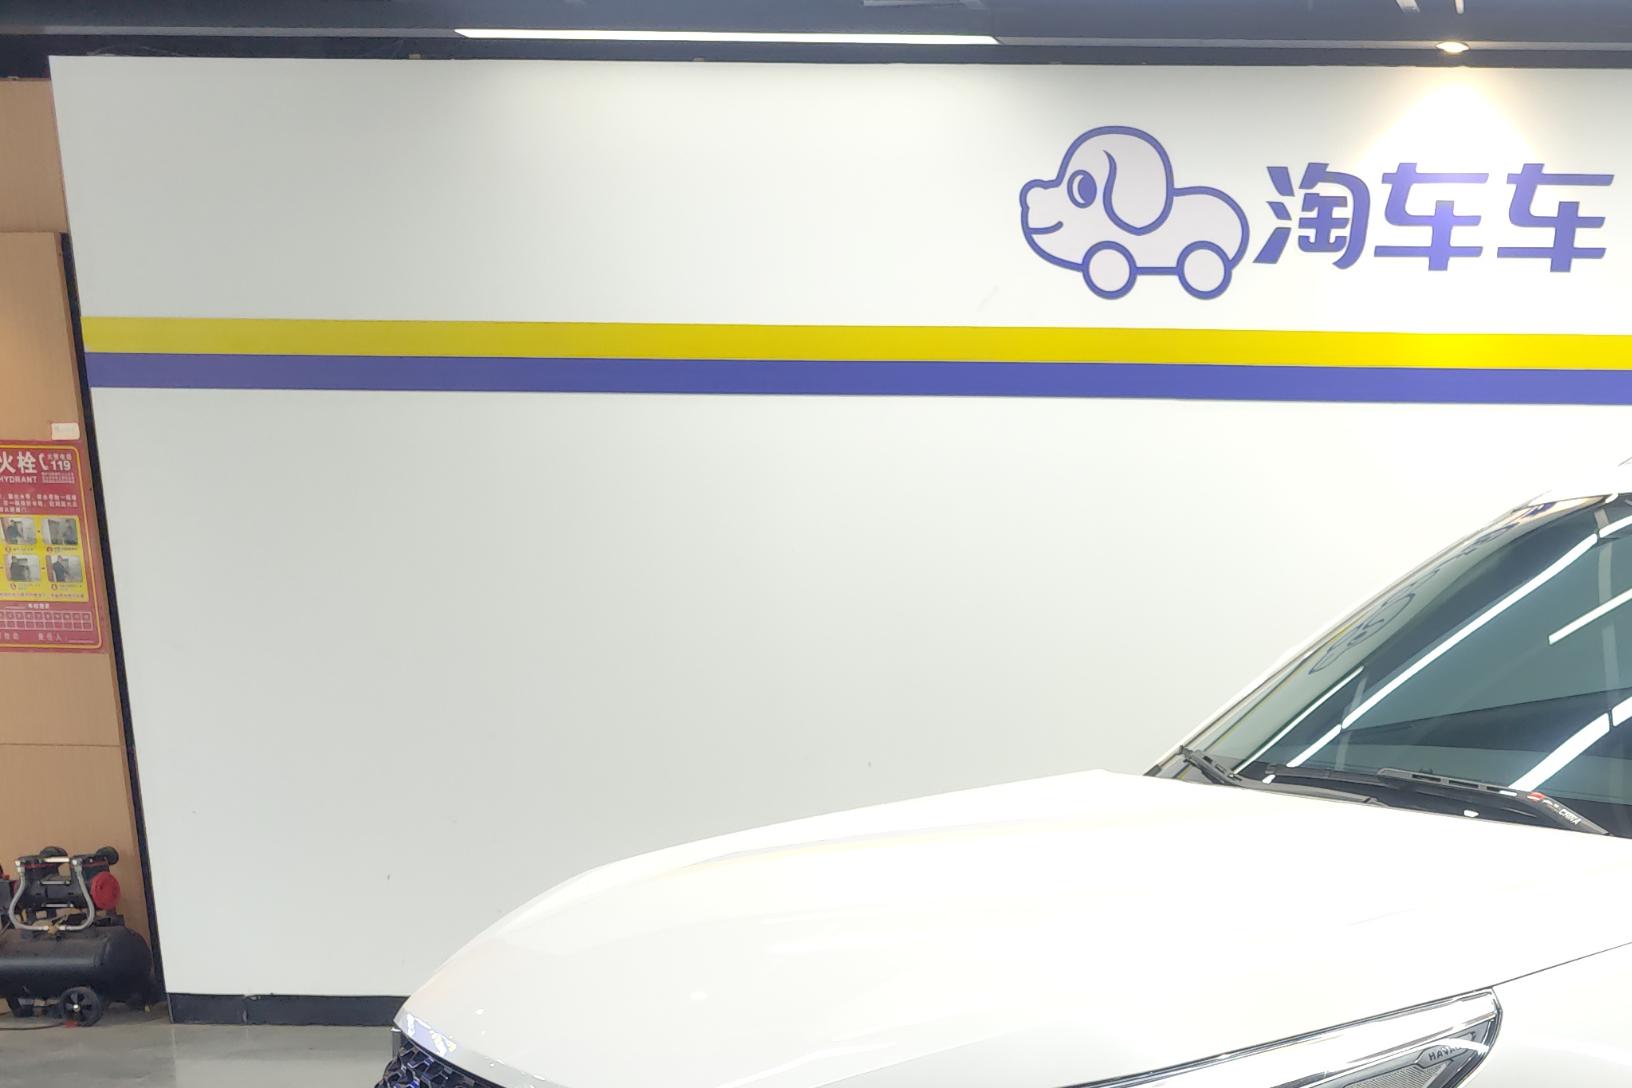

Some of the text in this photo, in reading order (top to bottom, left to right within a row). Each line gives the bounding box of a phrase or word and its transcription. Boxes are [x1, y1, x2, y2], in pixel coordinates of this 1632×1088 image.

[1253, 162, 1614, 272] 淘车车
[50, 460, 71, 471] 119
